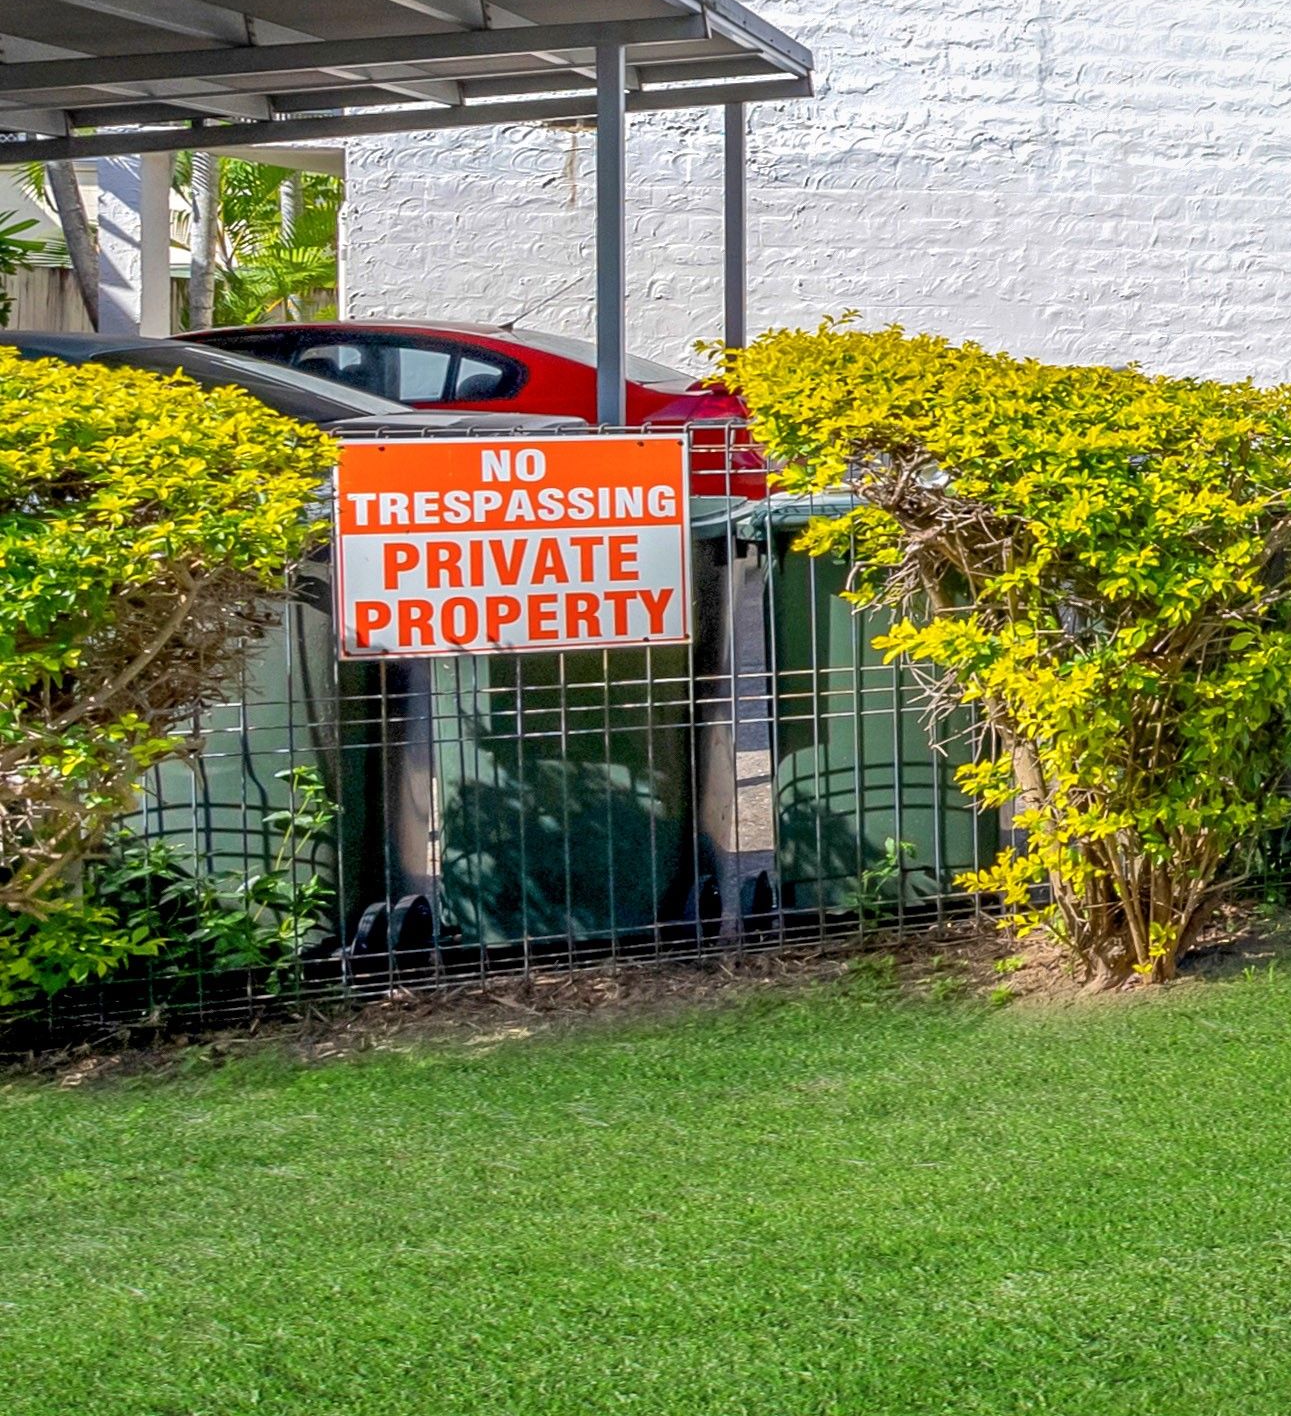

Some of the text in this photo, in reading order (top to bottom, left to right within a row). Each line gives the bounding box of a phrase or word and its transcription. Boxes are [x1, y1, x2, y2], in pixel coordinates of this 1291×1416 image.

[481, 448, 547, 483] NO
[346, 485, 676, 527] TRESPASSING
[383, 534, 640, 591] PRIVATE
[355, 588, 675, 649] PROPERTY
